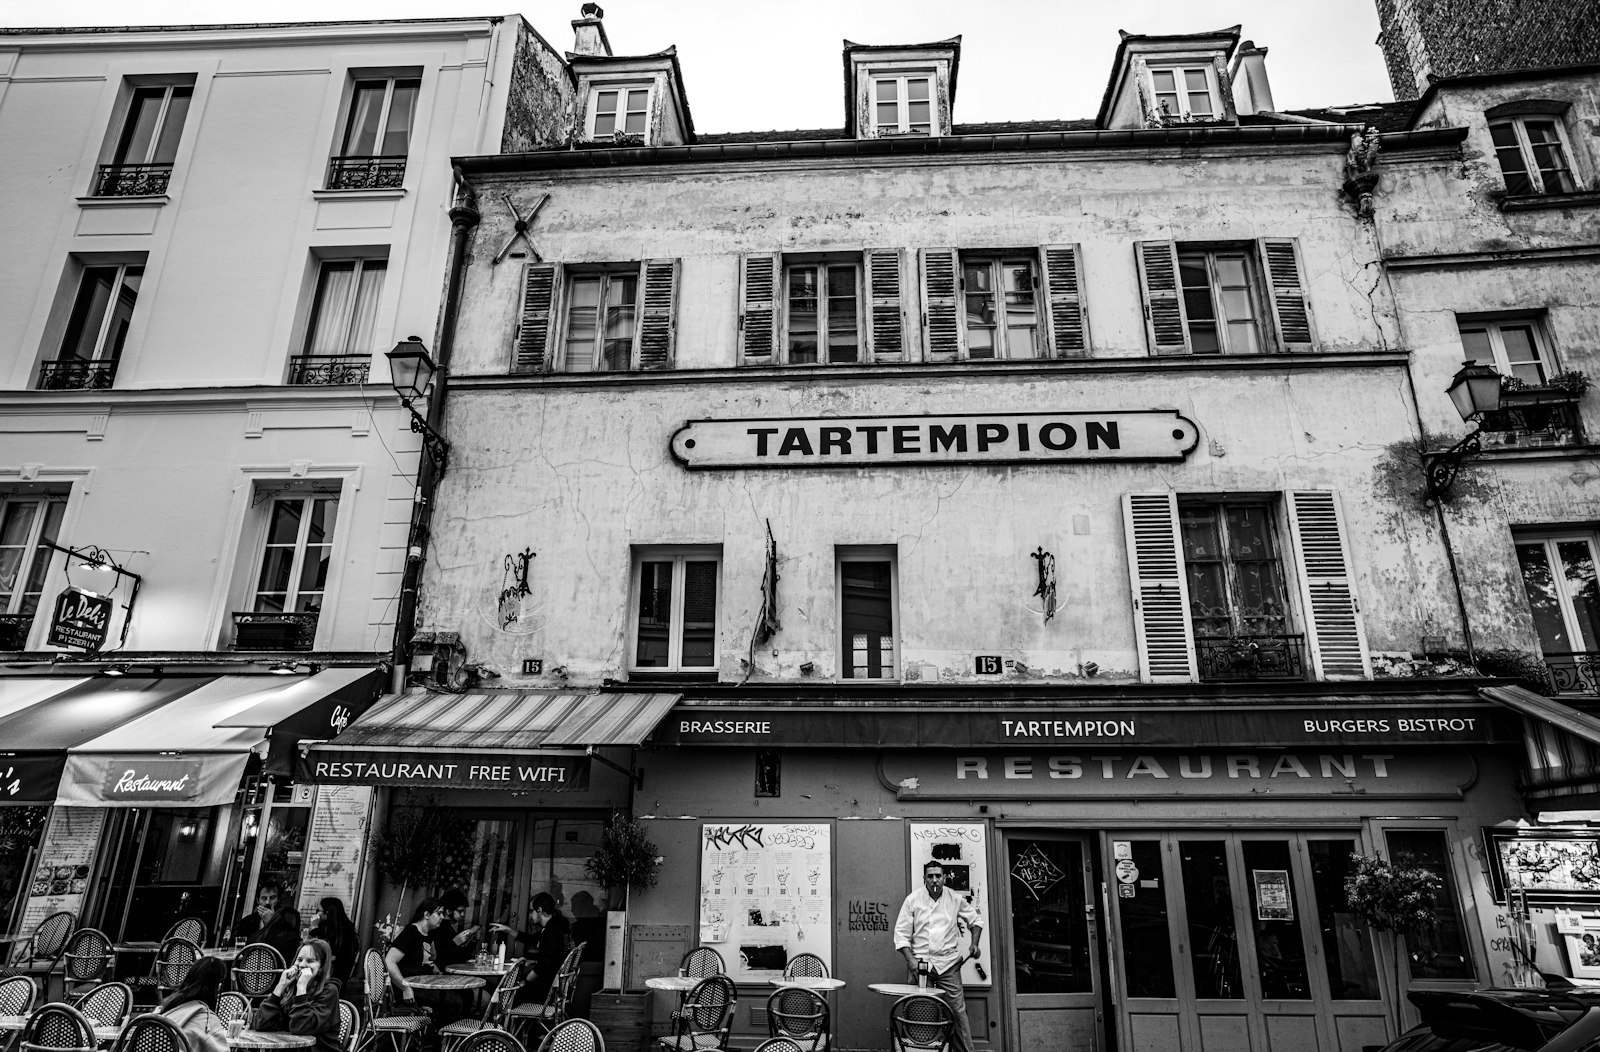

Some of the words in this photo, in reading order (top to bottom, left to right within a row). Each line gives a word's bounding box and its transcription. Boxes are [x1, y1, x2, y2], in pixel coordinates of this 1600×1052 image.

[747, 421, 1121, 456] TARTEMPION
[59, 597, 75, 622] Le
[76, 594, 106, 629] Deli's
[55, 625, 102, 641] RESTAURANT
[58, 634, 95, 649] PIZZERIA
[525, 661, 540, 673] 15
[980, 657, 998, 673] 15
[330, 705, 351, 734] Café
[679, 720, 771, 734] BRASSERIE
[1304, 719, 1390, 733] BURGERS
[1398, 718, 1476, 732] BISTROT
[1002, 720, 1136, 737] TARTEMPION
[315, 762, 458, 780] RESTAURANT
[469, 765, 511, 781] FREE
[518, 766, 566, 782] WIFI
[955, 754, 1394, 780] RESTAURANT
[113, 769, 190, 793] Restaurant
